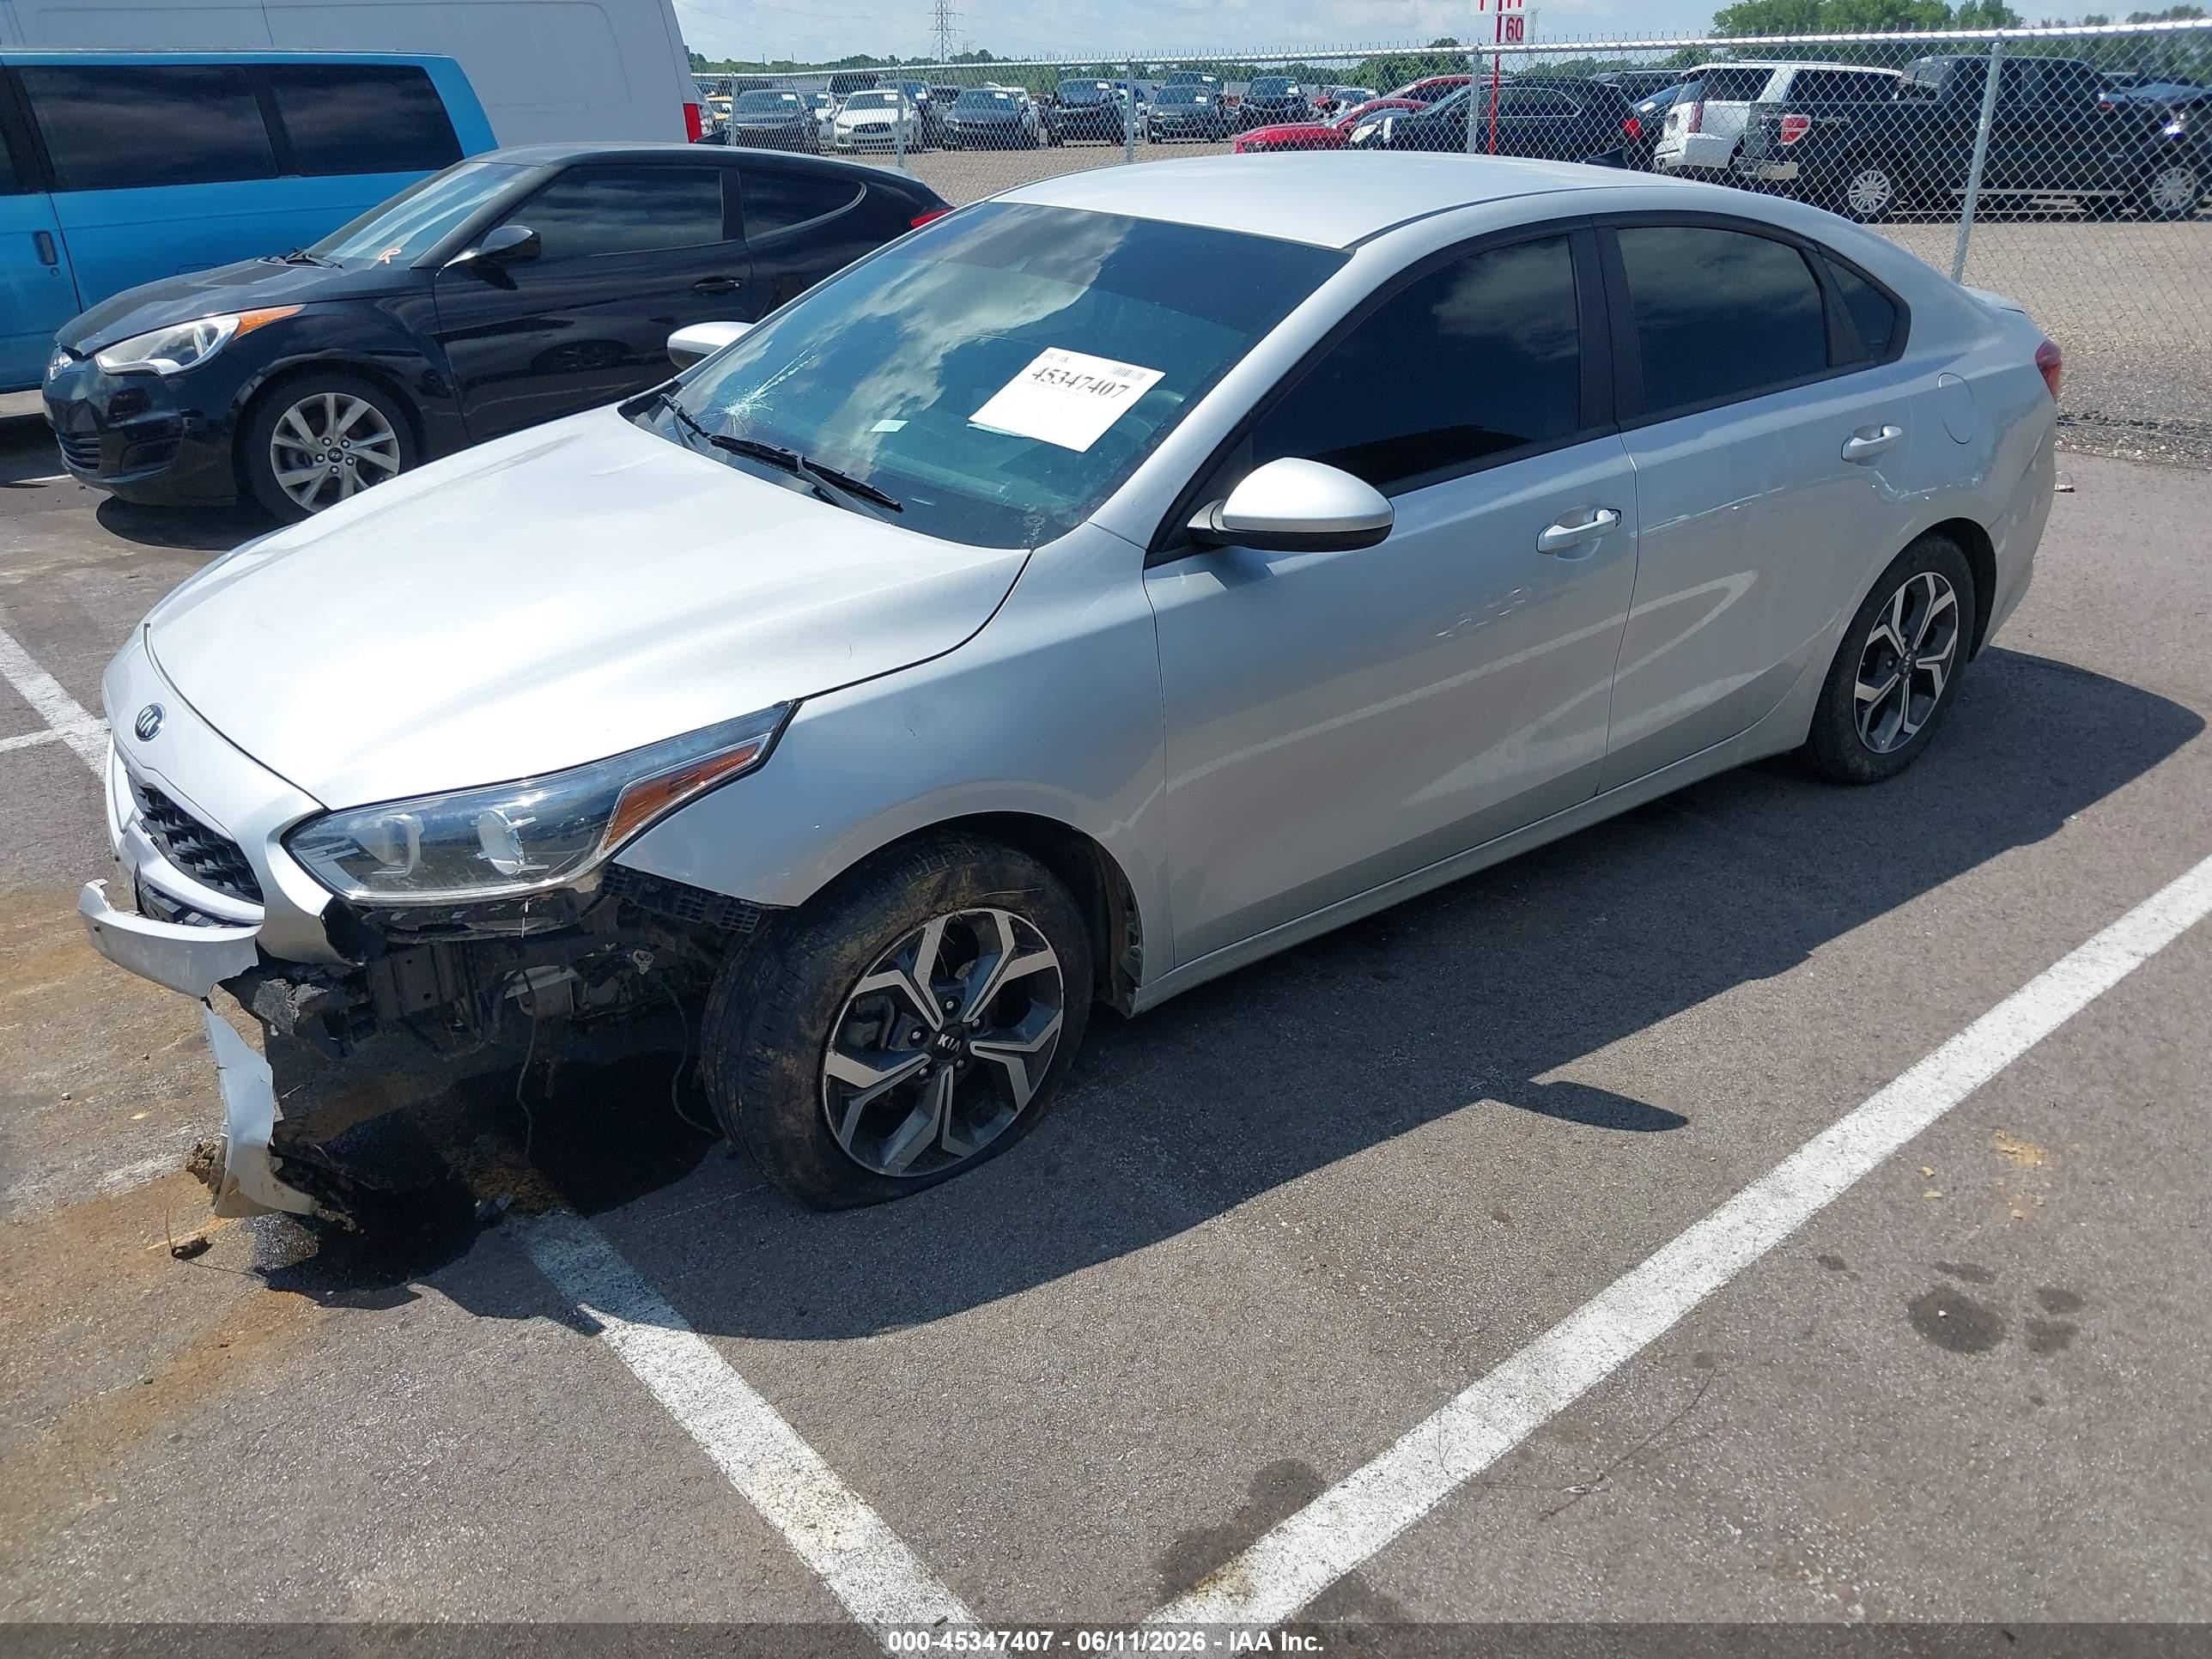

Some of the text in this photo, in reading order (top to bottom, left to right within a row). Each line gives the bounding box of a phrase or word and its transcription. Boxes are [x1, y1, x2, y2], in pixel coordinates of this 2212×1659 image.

[1506, 16, 1523, 42] 60
[1032, 367, 1130, 398] 45347407
[937, 1033, 961, 1053] KIA
